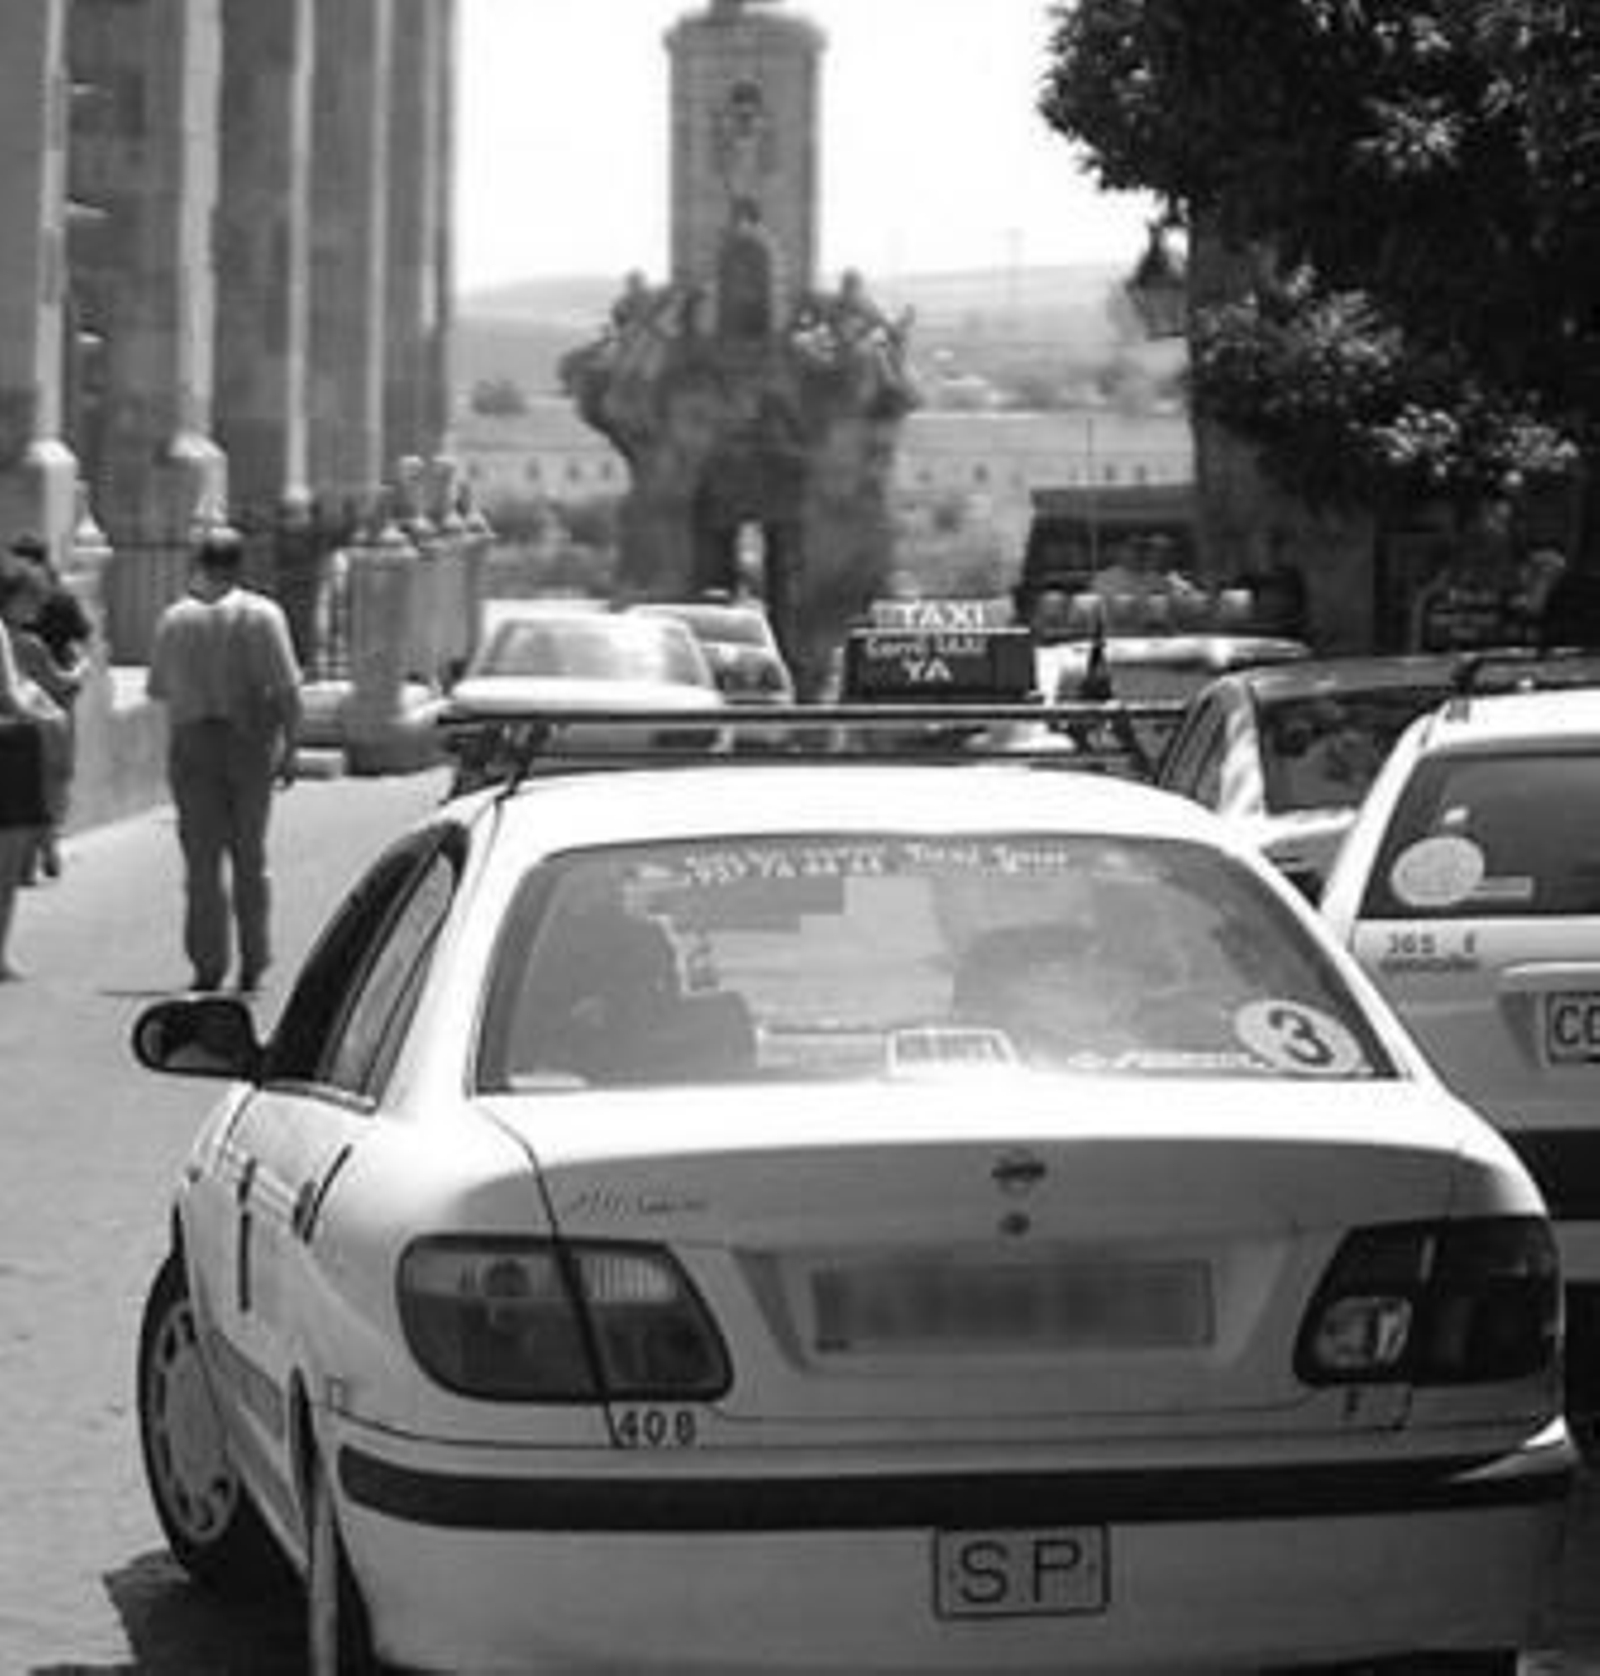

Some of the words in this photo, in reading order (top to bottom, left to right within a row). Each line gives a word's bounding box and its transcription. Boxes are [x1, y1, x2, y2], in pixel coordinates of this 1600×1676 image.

[898, 602, 984, 627] TAXI
[1267, 1008, 1336, 1066] 3
[614, 1409, 697, 1445] 408
